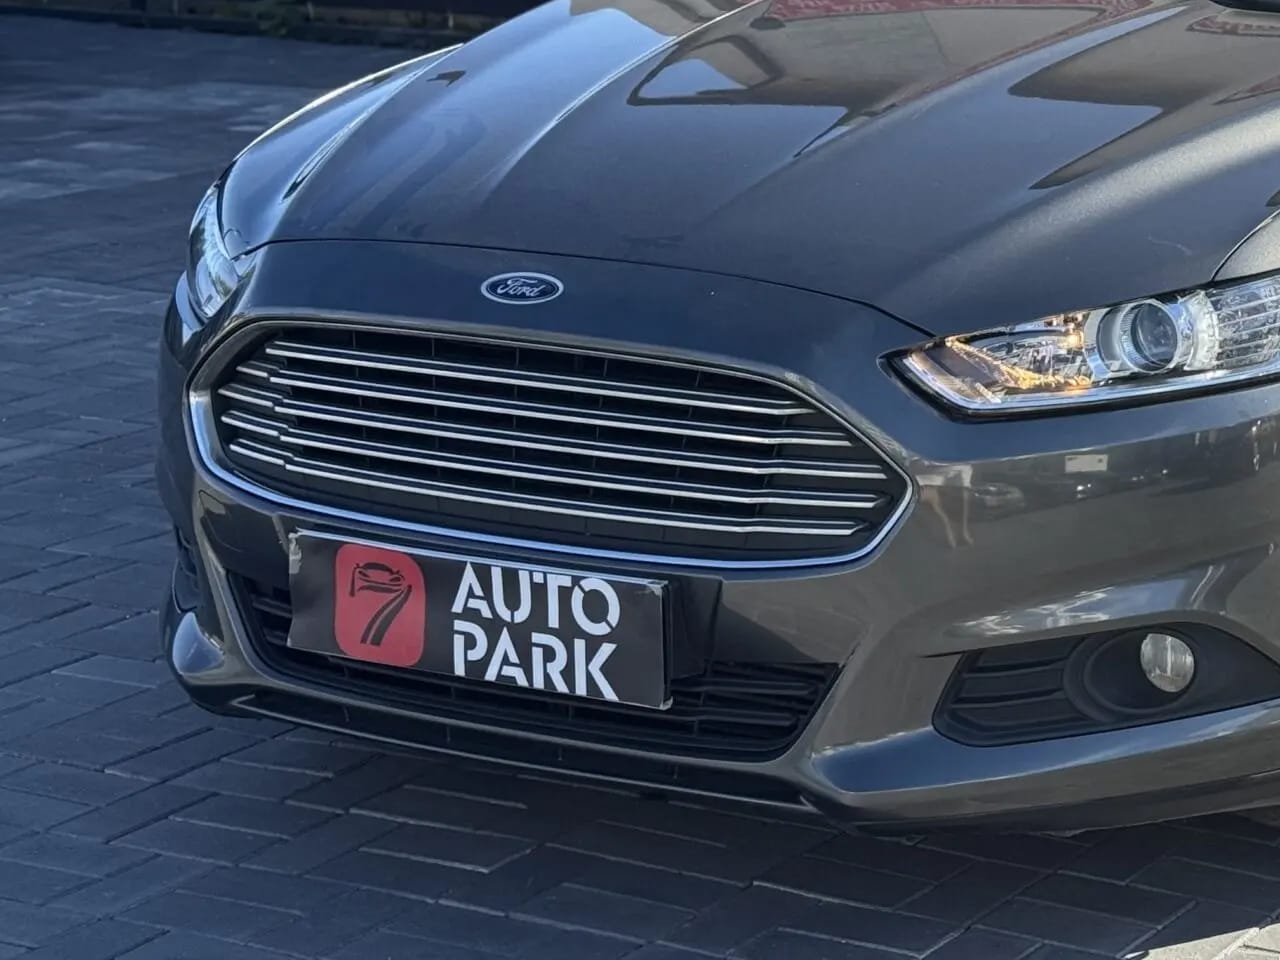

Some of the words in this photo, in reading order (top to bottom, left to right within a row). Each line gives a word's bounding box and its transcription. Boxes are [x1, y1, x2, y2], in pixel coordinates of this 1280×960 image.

[497, 277, 546, 297] Ford
[451, 561, 620, 635] AUTO
[453, 620, 619, 701] PARK
